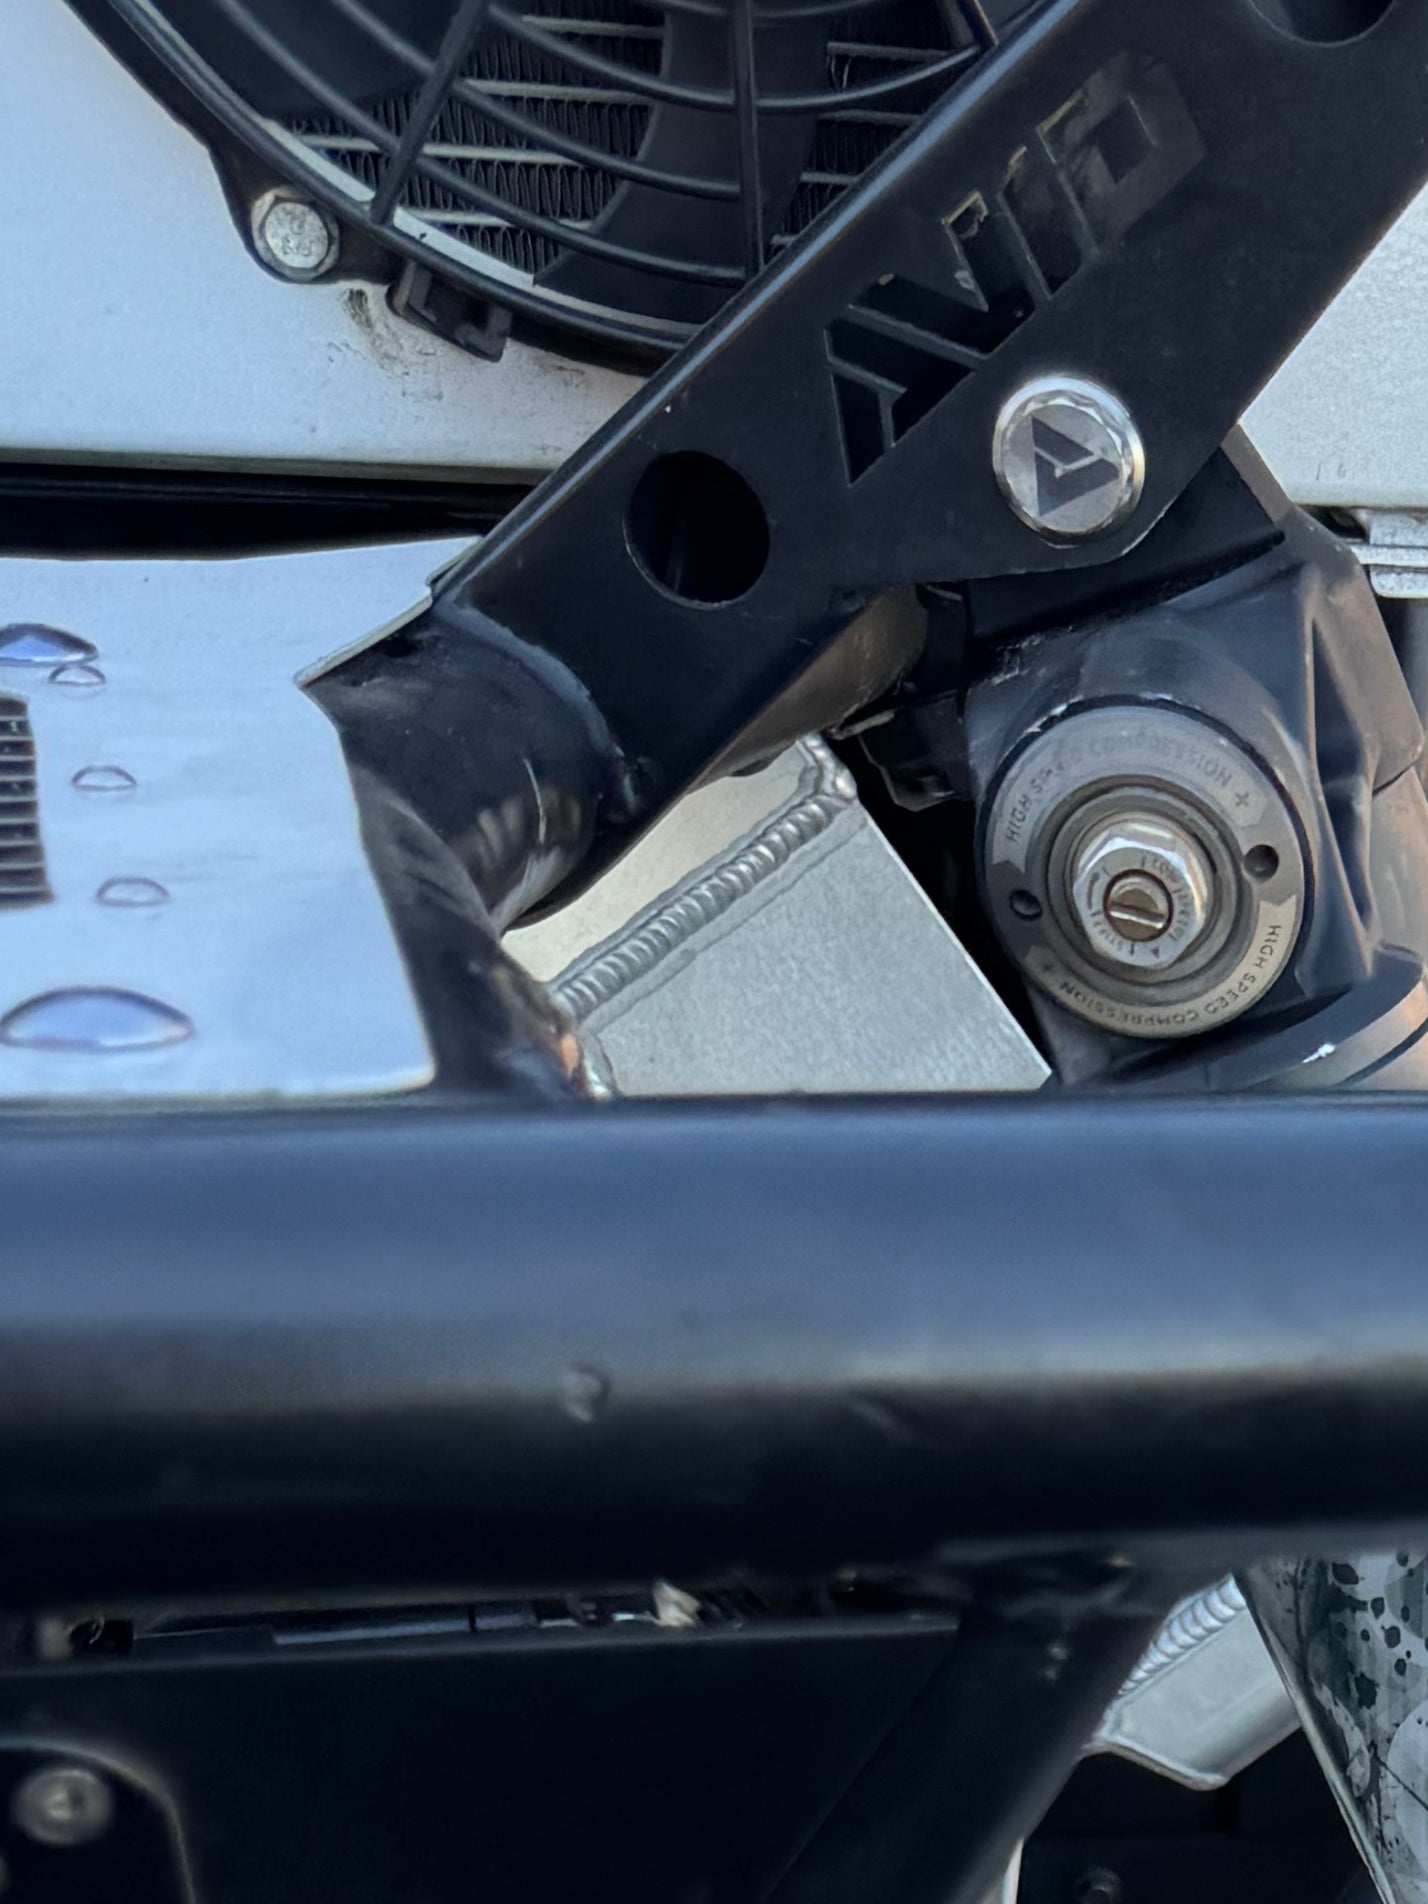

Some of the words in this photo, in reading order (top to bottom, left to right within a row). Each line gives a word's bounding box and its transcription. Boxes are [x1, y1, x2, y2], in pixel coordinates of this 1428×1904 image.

[823, 50, 1203, 488] AVID
[1003, 792, 1033, 844] HIGH
[1255, 923, 1283, 970] HIGH
[1058, 980, 1200, 1027] COMPRESSION
[1203, 970, 1257, 1015] SPEED
